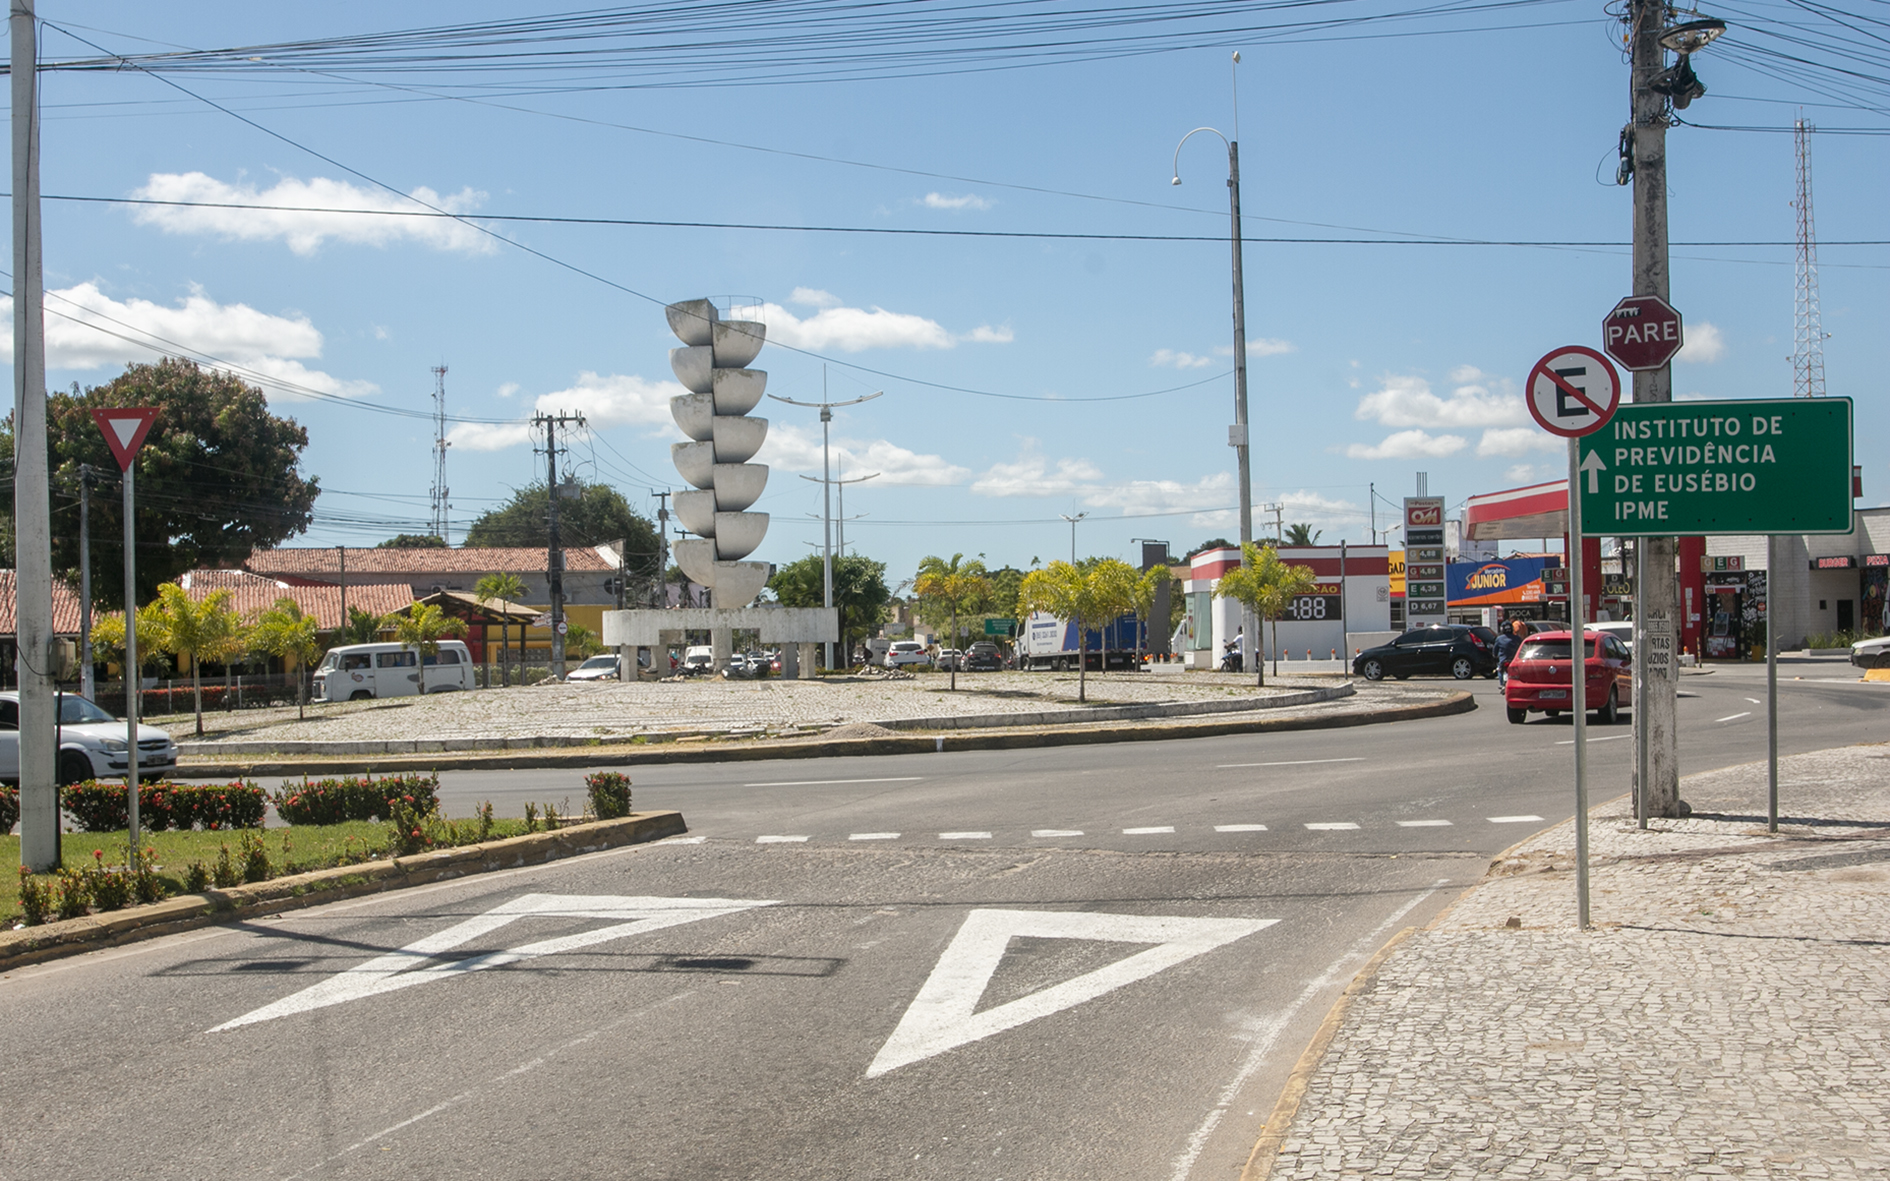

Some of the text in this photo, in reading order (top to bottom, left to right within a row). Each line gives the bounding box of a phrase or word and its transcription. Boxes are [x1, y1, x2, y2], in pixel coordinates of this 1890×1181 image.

[1608, 321, 1677, 346] PARE
[1555, 367, 1589, 417] E
[1615, 416, 1783, 440] INSTITUTO DE
[1615, 441, 1776, 466] PREVIDÊNCIA
[1615, 470, 1756, 493] DE EUSÉBIO
[1615, 501, 1669, 520] IPME
[1704, 557, 1738, 567] G E G
[1818, 557, 1849, 568] BURGER
[1866, 555, 1889, 566] PIZZA
[1410, 567, 1417, 575] G
[1544, 569, 1563, 578] E G
[1471, 573, 1506, 589] JUNIOR
[1611, 574, 1618, 582] D
[1410, 585, 1417, 593] E
[1411, 602, 1419, 610] D
[1651, 638, 1670, 650] RTAS
